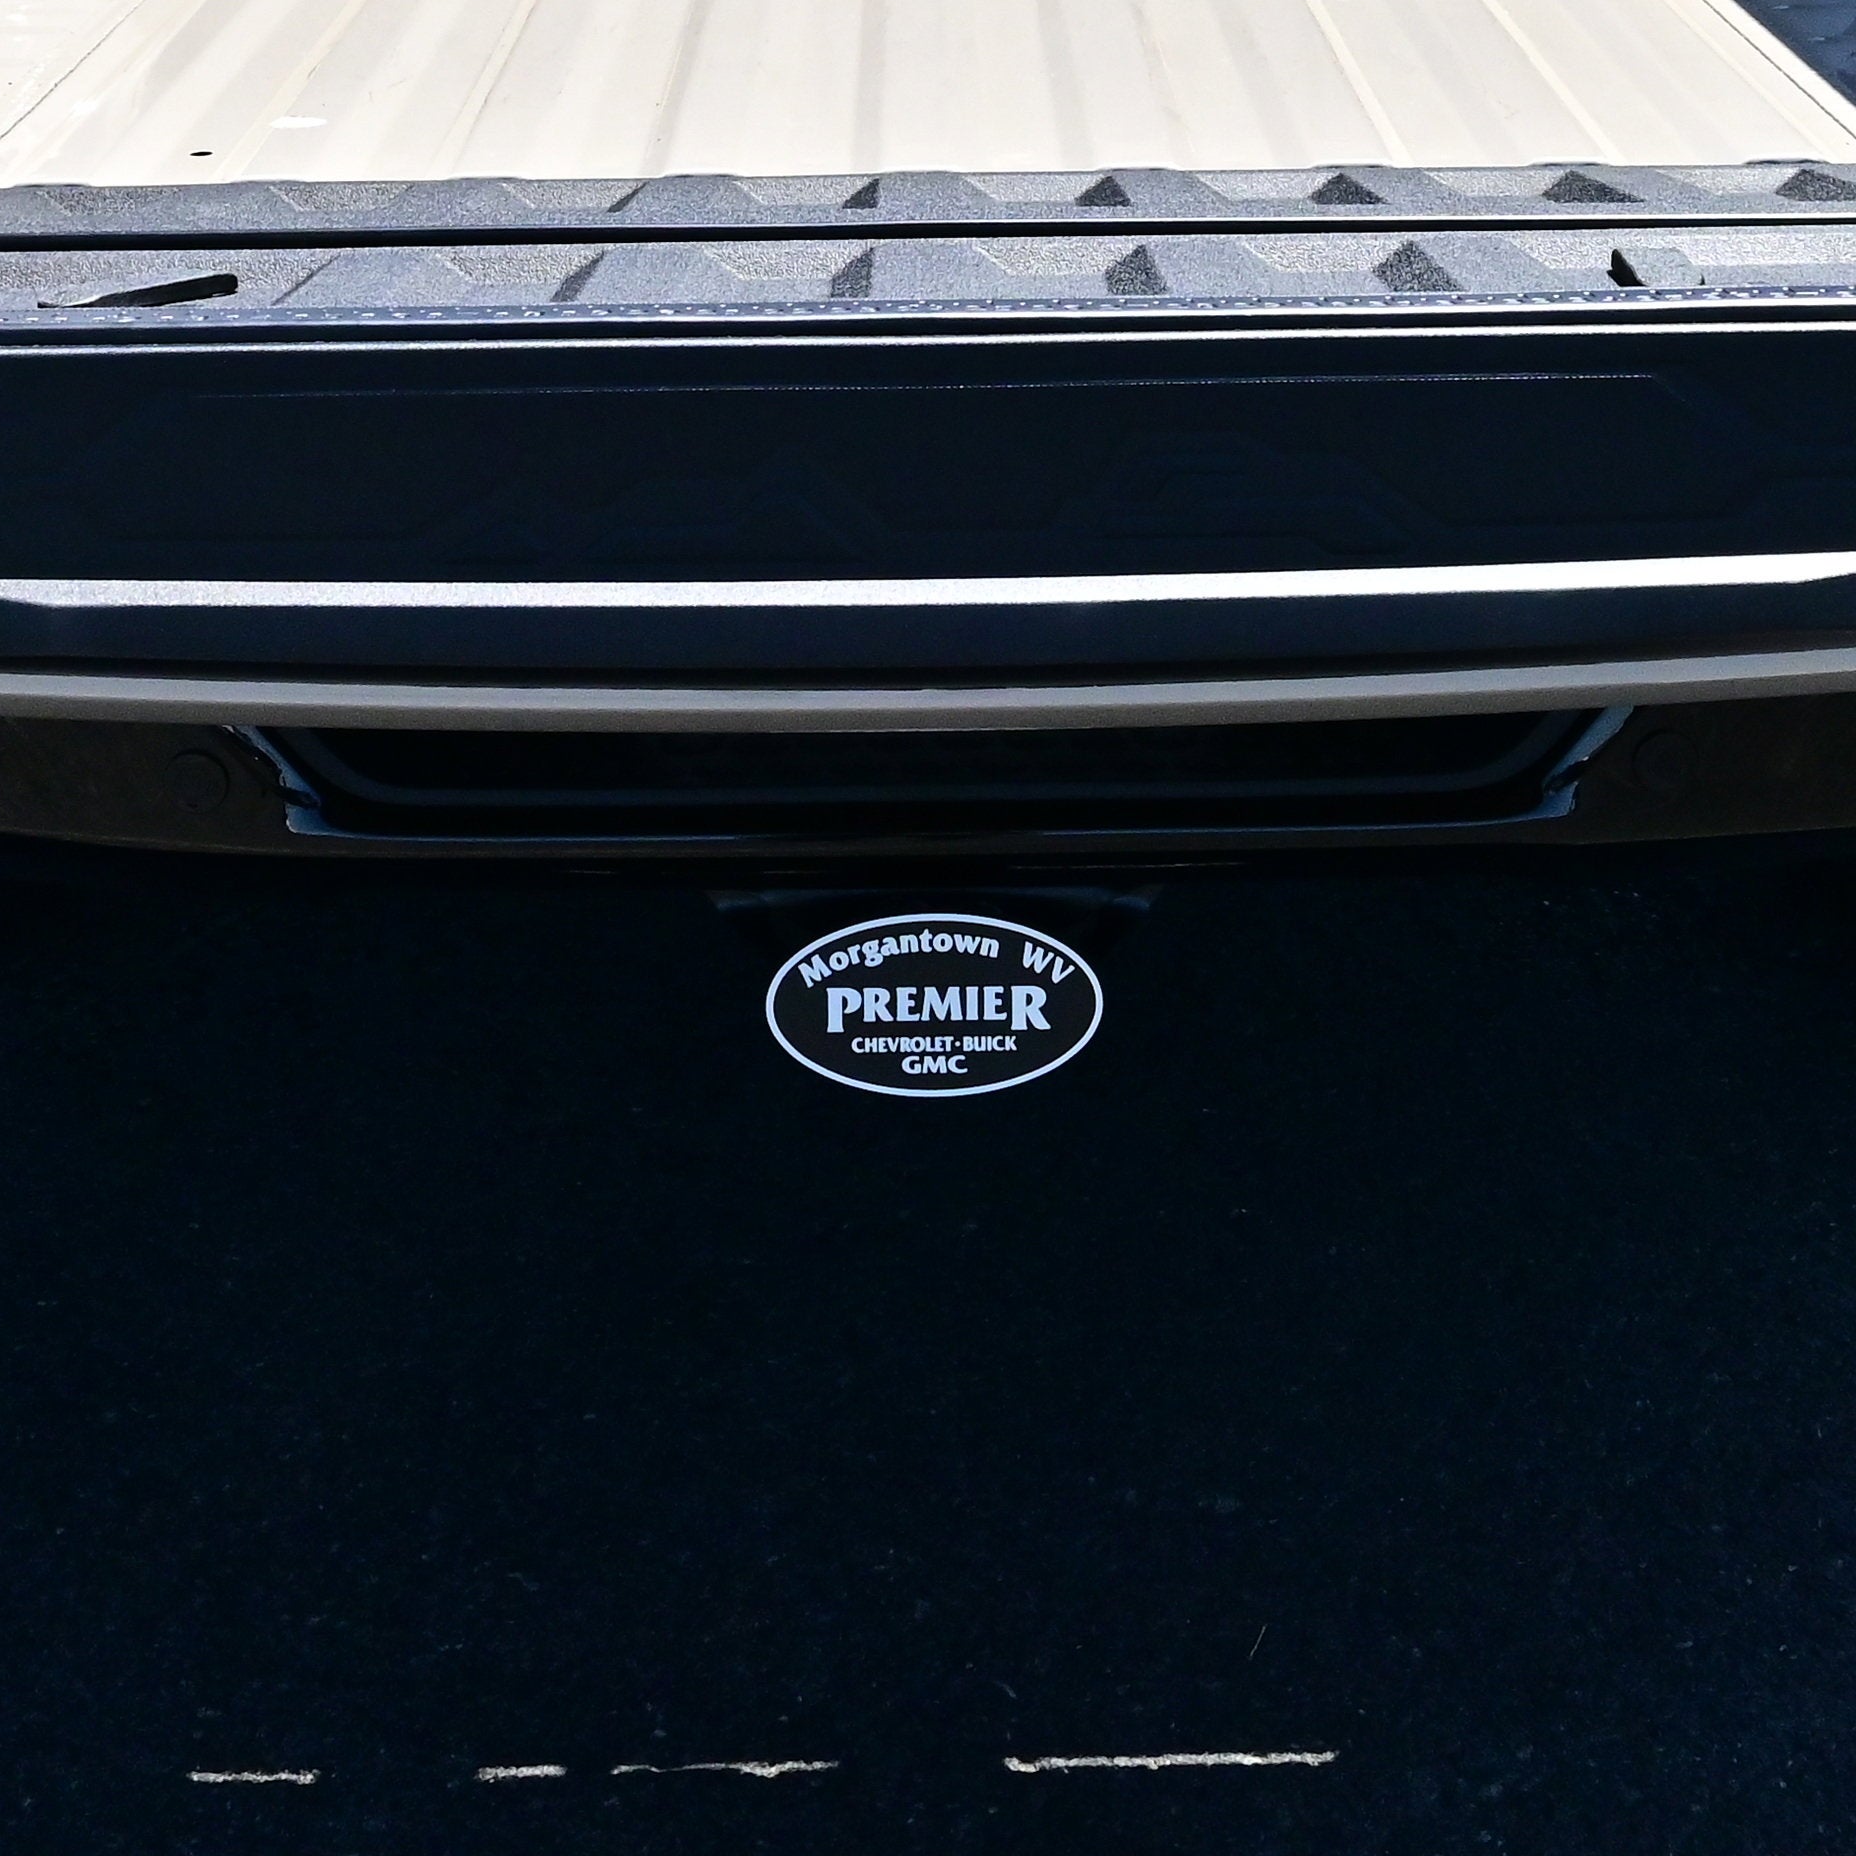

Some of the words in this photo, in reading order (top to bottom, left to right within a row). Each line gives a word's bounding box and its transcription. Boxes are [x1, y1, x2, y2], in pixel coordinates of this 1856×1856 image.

[798, 929, 999, 988] Morgantown
[1021, 941, 1077, 986] WV
[825, 984, 1052, 1033] PREMIER
[900, 1054, 968, 1075] GMC
